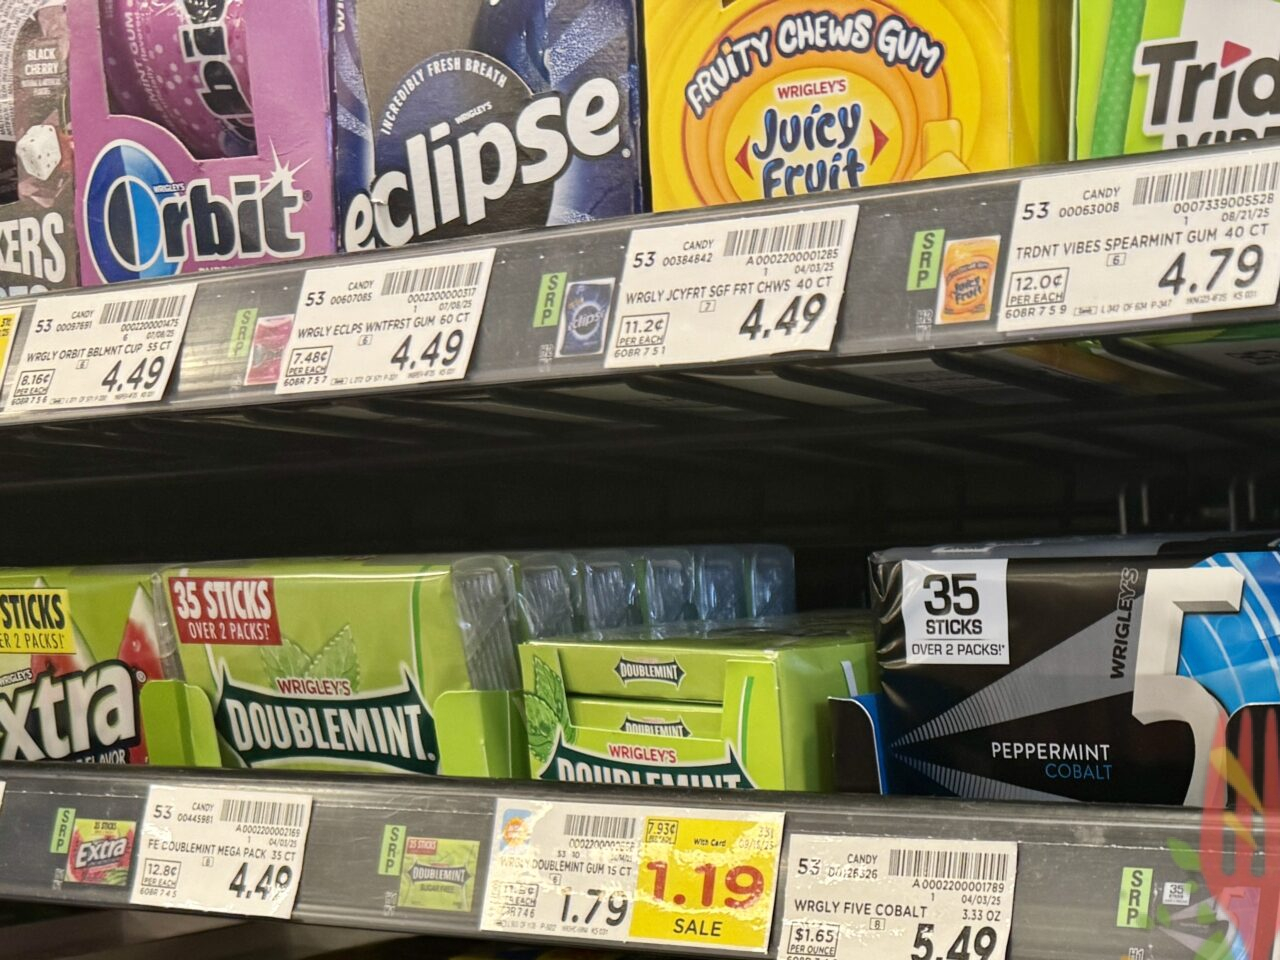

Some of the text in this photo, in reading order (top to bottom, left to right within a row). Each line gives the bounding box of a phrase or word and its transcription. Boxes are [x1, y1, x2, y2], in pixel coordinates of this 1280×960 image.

[25, 60, 58, 75] CHERRY
[27, 48, 56, 61] BLACK
[684, 16, 943, 117] FRUITY CHEWS GUM
[381, 58, 508, 135] INCREDIBLY FRESH BREATH
[776, 79, 846, 99] WRIGLEY'S
[752, 103, 862, 159] Juicy
[343, 77, 620, 252] eclipse
[761, 153, 863, 198] Fruit
[85, 138, 305, 283] Orbit
[1016, 223, 1268, 260] TRDNT VIBES SPEARMINT GUM 40 CT
[1159, 245, 1263, 294] 4.79
[739, 292, 826, 339] 4.49
[391, 329, 463, 368] 4.49
[102, 357, 165, 390] 4.49
[0, 593, 65, 630] STICKS
[174, 581, 271, 620] 35 STICKS
[923, 574, 979, 616] 35
[188, 622, 214, 638] OVER
[218, 623, 226, 637] 2
[925, 620, 983, 635] STICKS
[1111, 568, 1138, 679] WRIGLEY'S
[912, 642, 943, 656] OVER
[946, 643, 954, 655] 2
[276, 677, 351, 696] WRIGLEY'S
[619, 662, 679, 681] DOUBLEMINT
[0, 665, 136, 761] xtra
[225, 699, 424, 759] DOUBLEMINT
[609, 744, 677, 763] WRIGLEY'S
[992, 742, 1110, 761] PEPPERMINT
[1046, 763, 1112, 779] COBALT
[646, 862, 765, 909] 1.19
[674, 918, 722, 937] SALE
